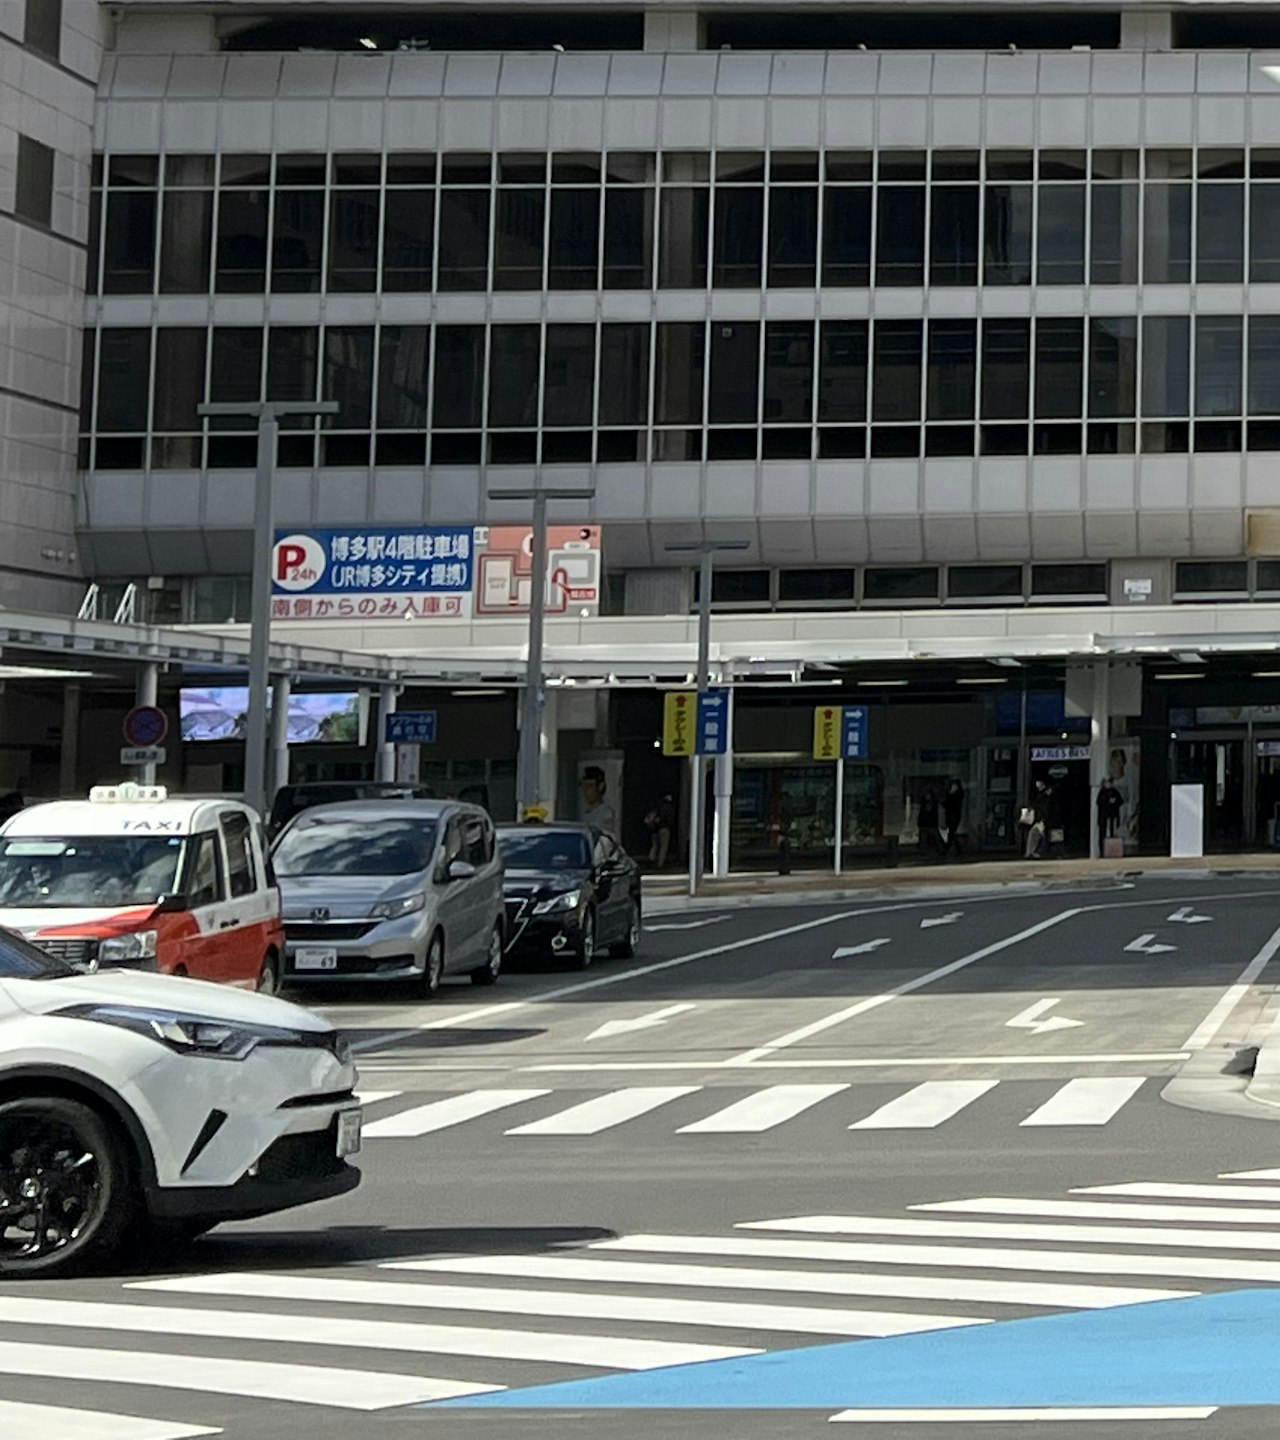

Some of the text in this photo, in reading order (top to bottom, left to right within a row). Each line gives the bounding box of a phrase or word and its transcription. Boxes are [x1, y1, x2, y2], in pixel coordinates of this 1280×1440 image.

[331, 533, 470, 561] 博多駅4階駐車場
[277, 544, 306, 581] P
[291, 567, 317, 582] 24h
[272, 596, 464, 617] 南側からのみ入庫可
[122, 820, 182, 831] TAXI
